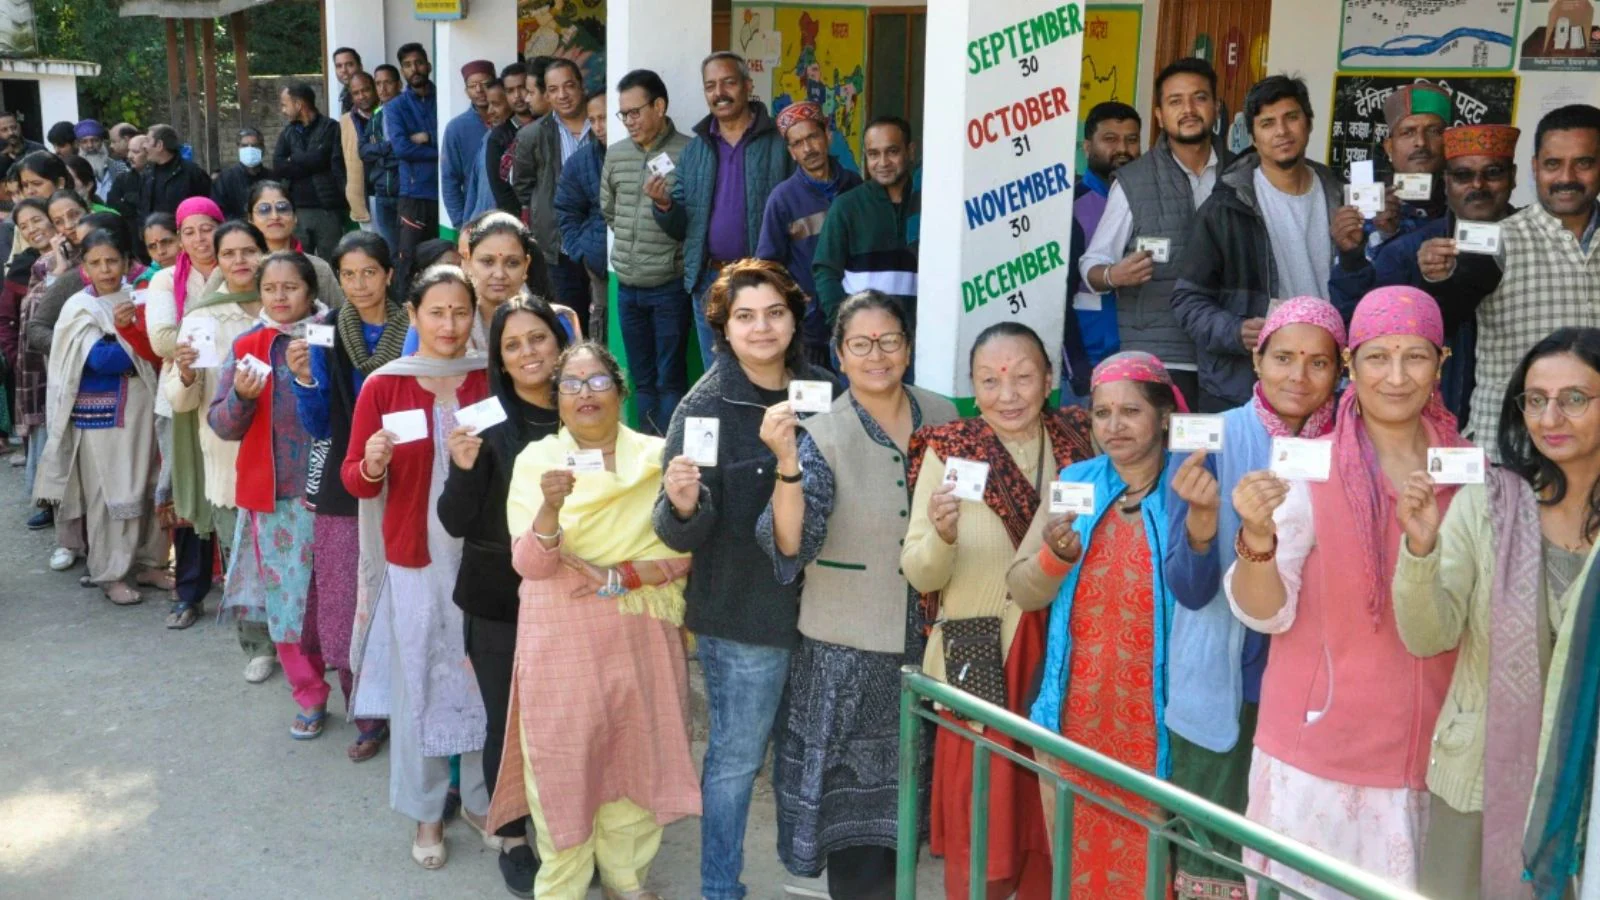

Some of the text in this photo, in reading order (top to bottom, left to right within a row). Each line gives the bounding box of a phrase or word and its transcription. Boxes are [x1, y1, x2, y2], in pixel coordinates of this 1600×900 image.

[968, 2, 1083, 74] SEPTEMBER
[1018, 55, 1039, 77] 30
[967, 87, 1070, 149] OCTOBER
[1012, 134, 1031, 156] 31
[964, 163, 1071, 231] NOVEMBER
[1008, 215, 1031, 238] 30
[961, 240, 1065, 313] DECEMBER
[1007, 290, 1027, 315] 31
